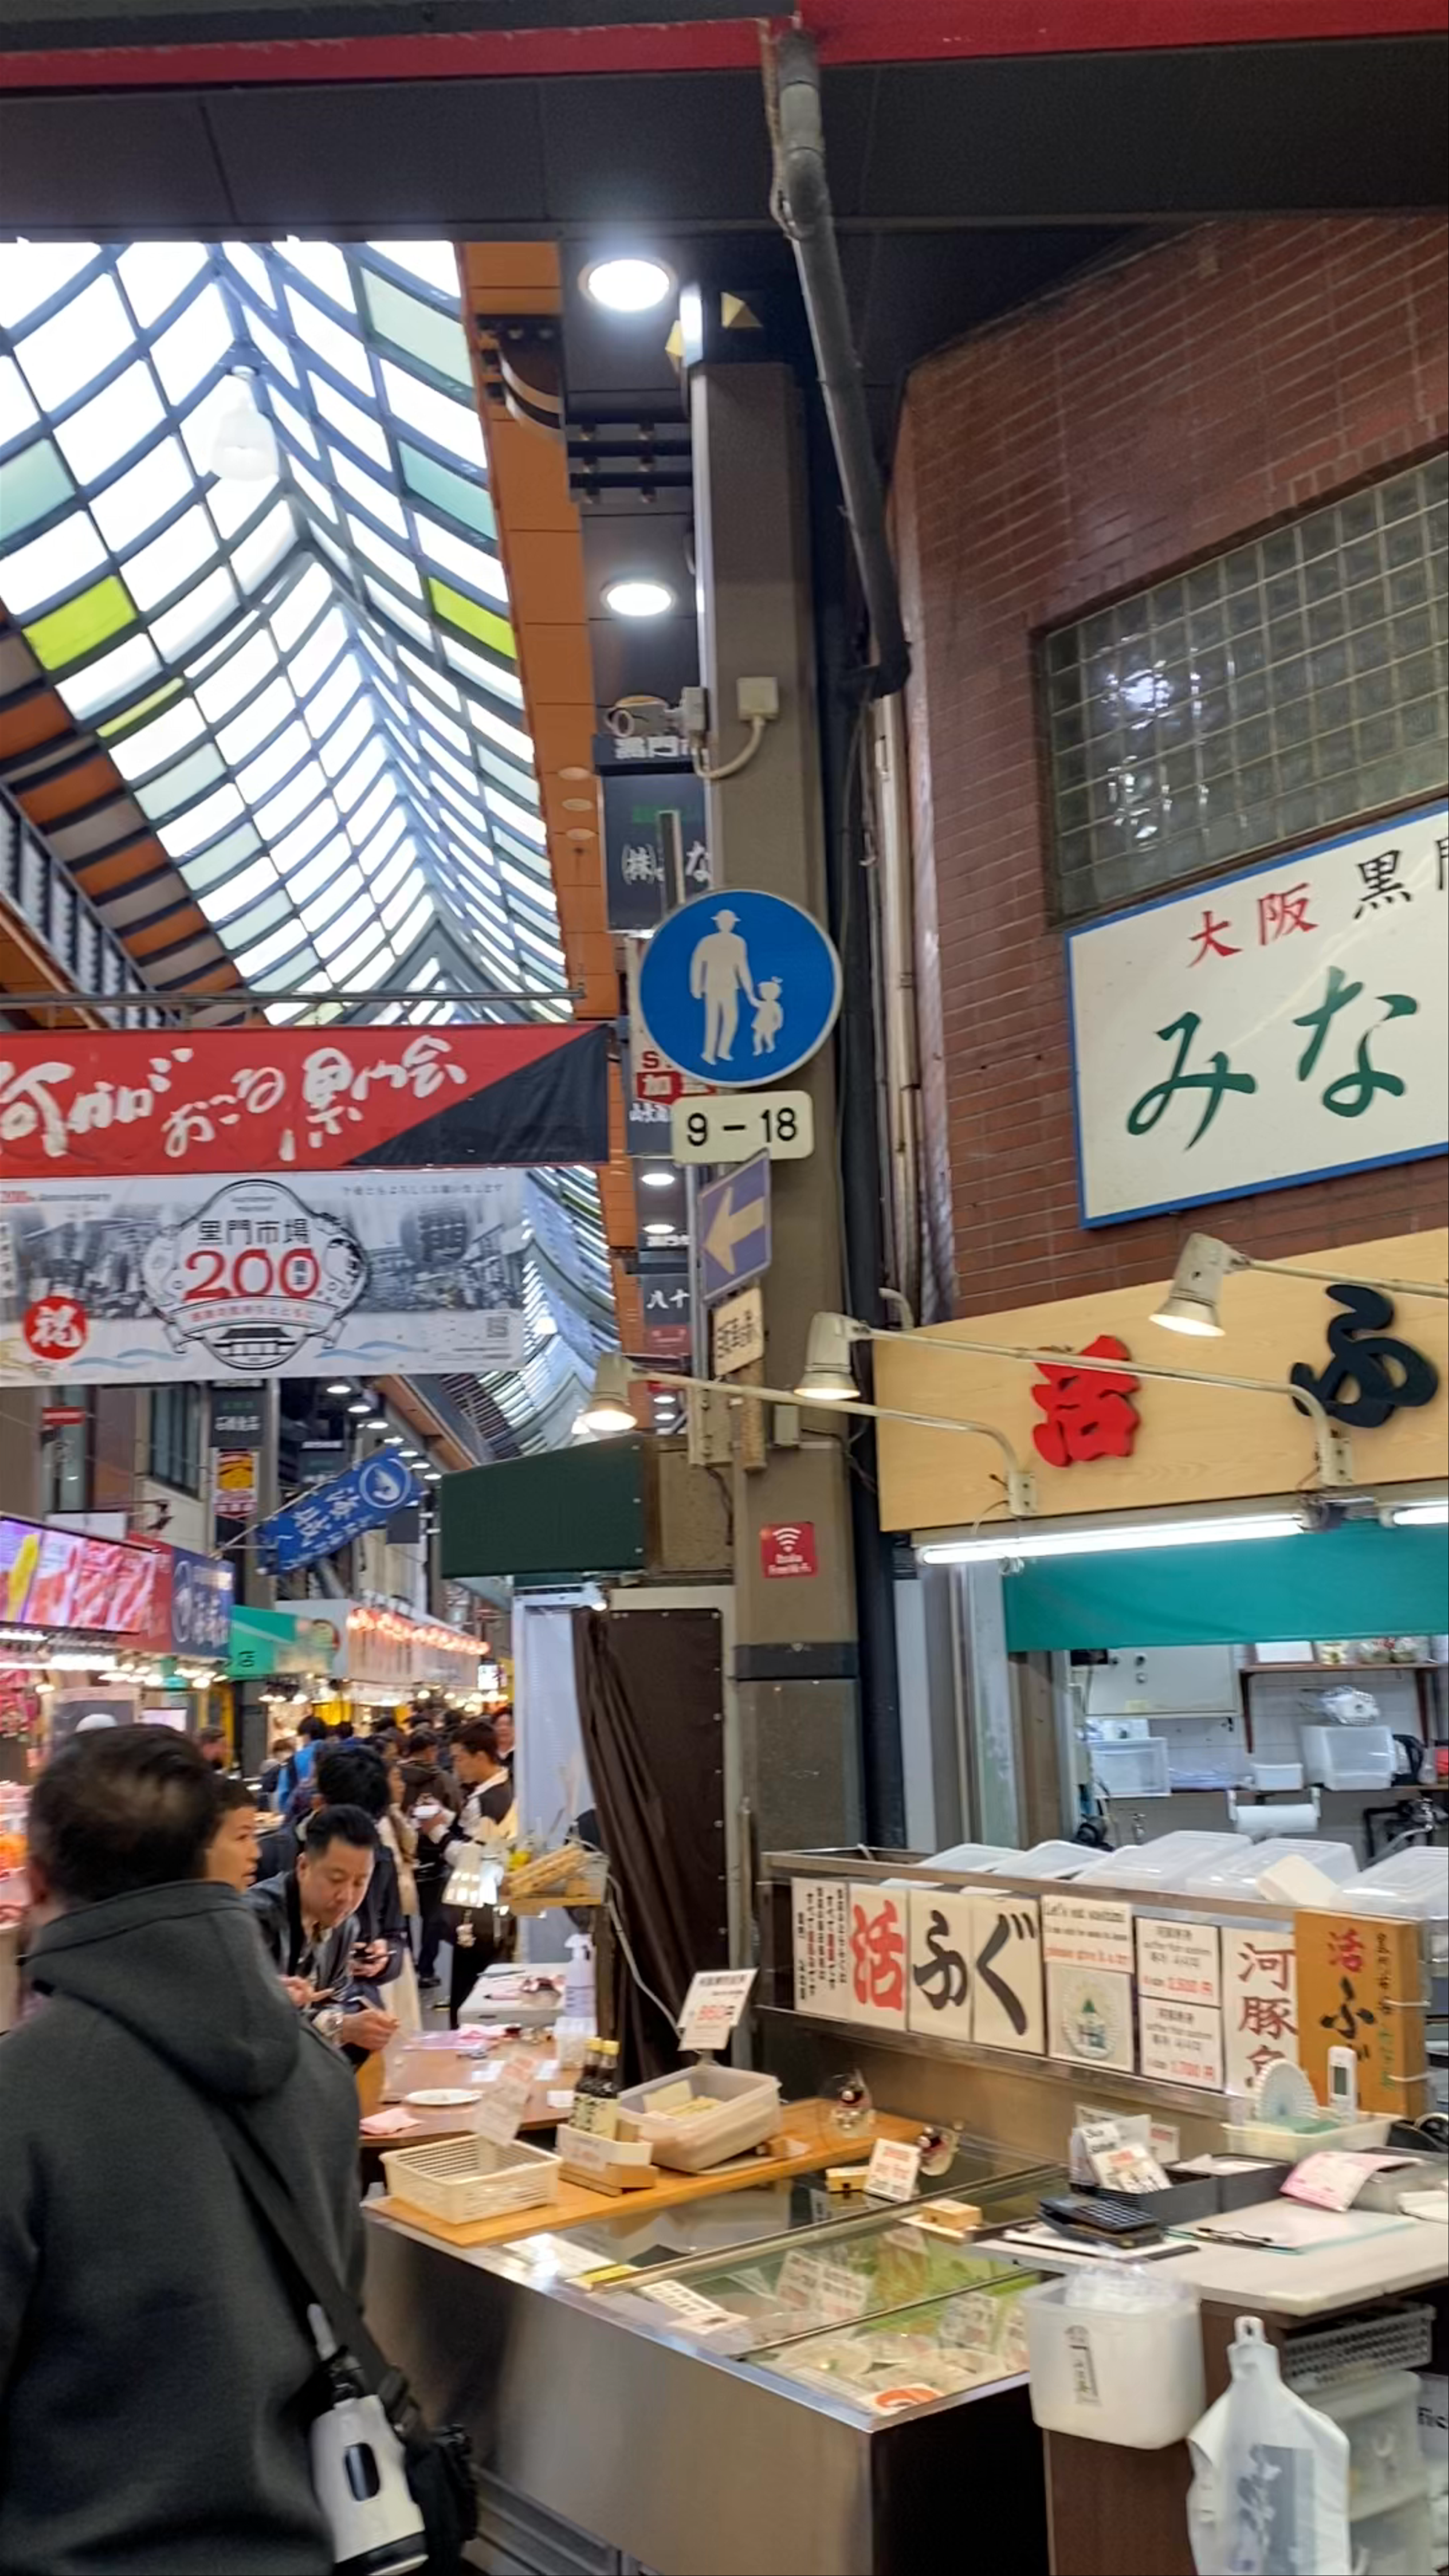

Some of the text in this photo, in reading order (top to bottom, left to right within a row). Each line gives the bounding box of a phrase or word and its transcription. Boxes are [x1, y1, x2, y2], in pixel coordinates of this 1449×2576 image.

[1127, 965, 1418, 1153] みな
[183, 1247, 321, 1302] 200
[197, 1219, 311, 1246] 黒門市場
[850, 1899, 1035, 2036] 活ふぐ
